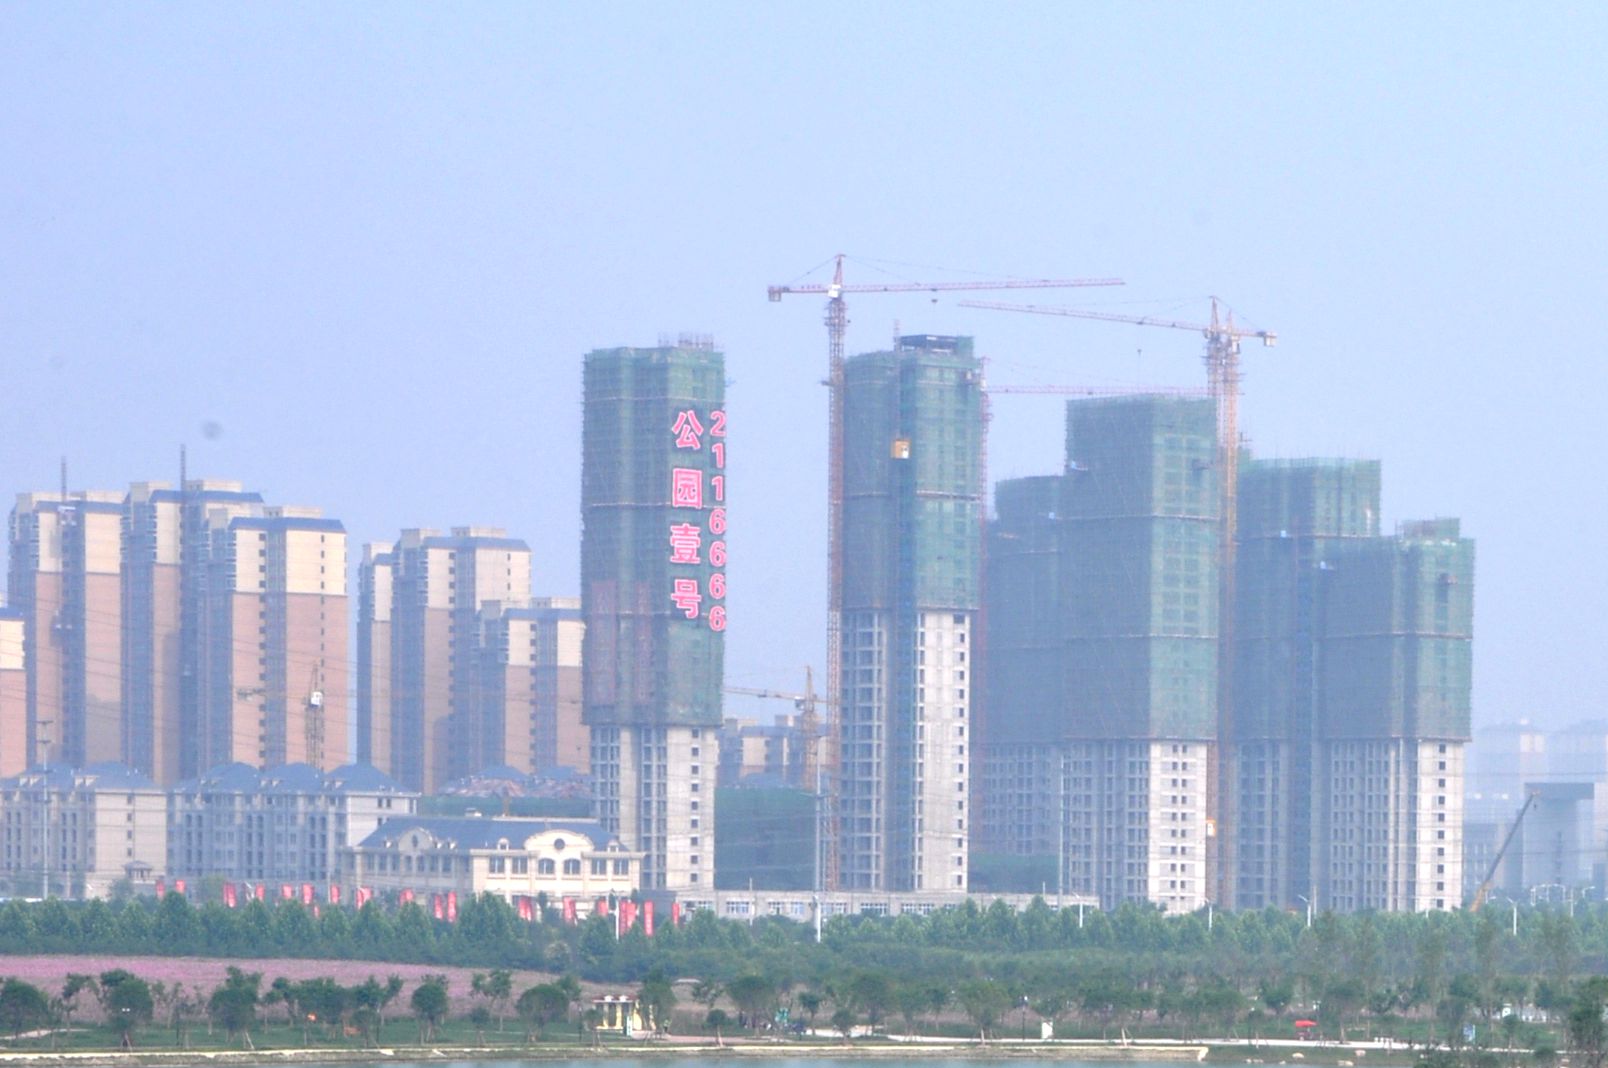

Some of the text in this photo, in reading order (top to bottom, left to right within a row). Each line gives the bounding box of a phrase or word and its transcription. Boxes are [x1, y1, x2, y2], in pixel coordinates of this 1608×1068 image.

[670, 410, 703, 619] 公园壹号
[709, 410, 726, 632] 2116666
